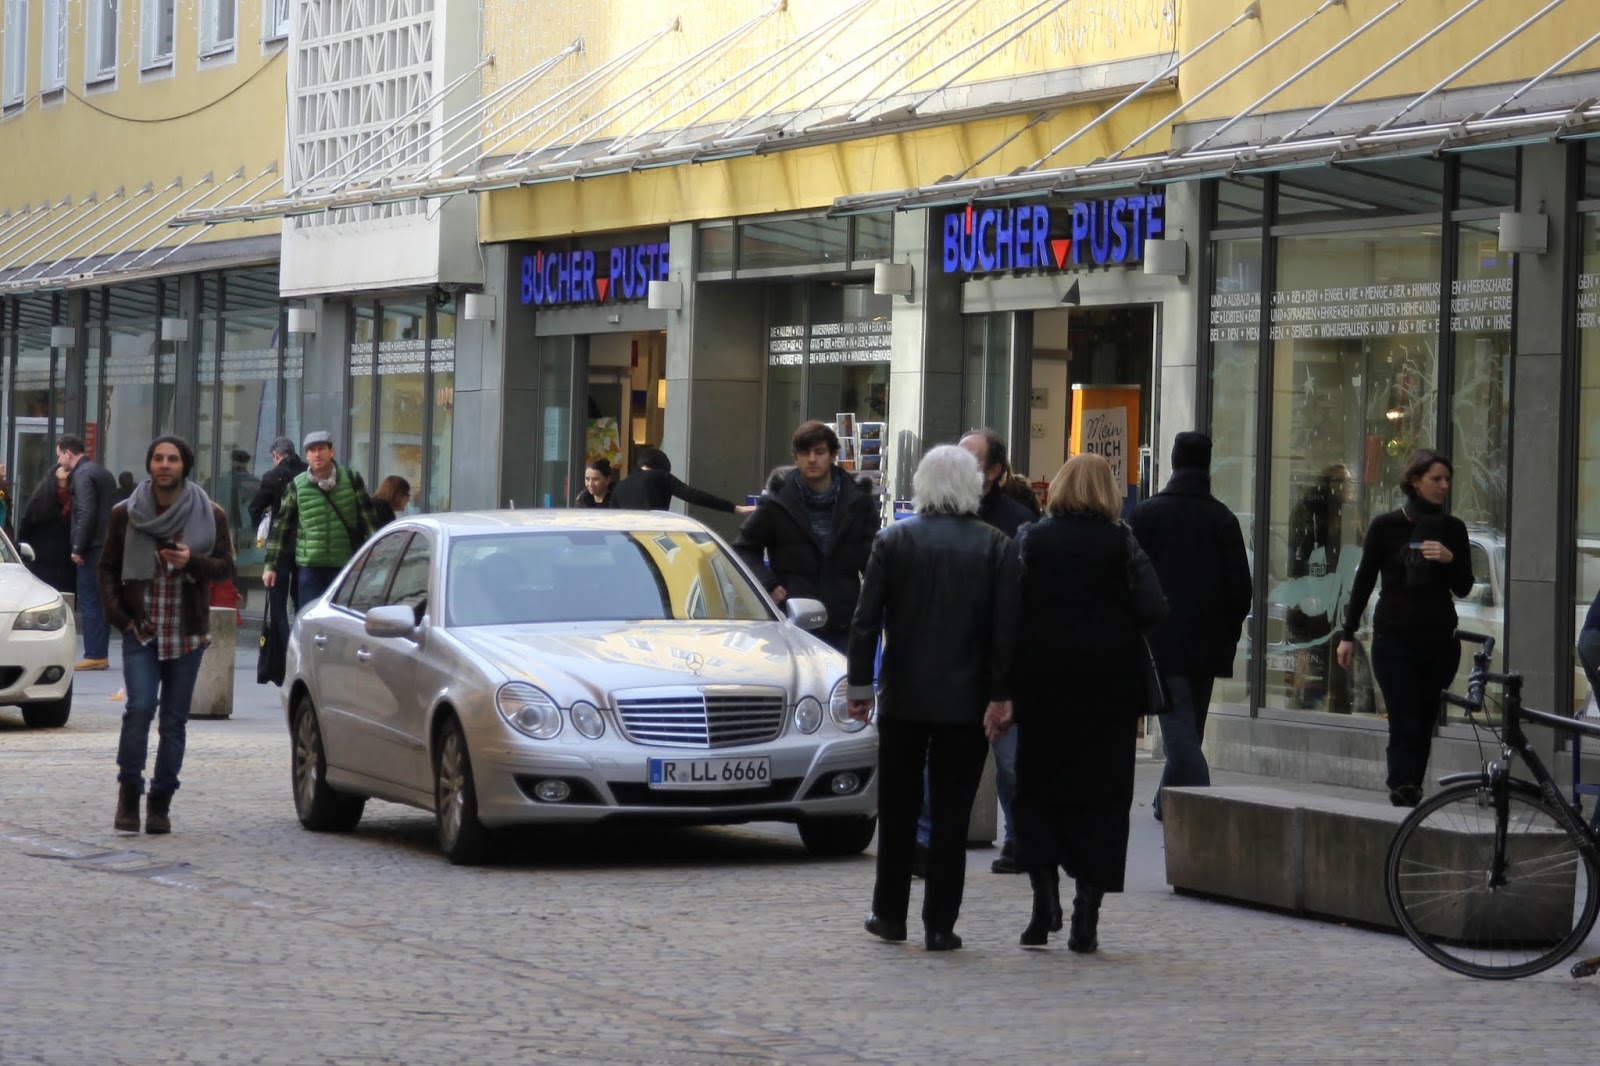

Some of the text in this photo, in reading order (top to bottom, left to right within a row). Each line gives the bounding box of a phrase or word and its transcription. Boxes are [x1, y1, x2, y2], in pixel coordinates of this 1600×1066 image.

[1577, 274, 1594, 290] GEN
[1211, 294, 1222, 307] UND
[1227, 292, 1250, 306] ALSBALD
[1324, 287, 1345, 301] ENGEL
[1349, 287, 1358, 300] DIE
[1365, 285, 1388, 299] MENGE
[1393, 284, 1406, 298] DER
[1474, 297, 1488, 311] AUF
[1577, 293, 1597, 309] NACH
[1211, 310, 1220, 323] DIE
[1223, 309, 1244, 323] LOBTEN
[1270, 308, 1283, 322] UND
[1286, 306, 1317, 321] SPRACHEN
[1320, 305, 1337, 319] EHRE
[1340, 305, 1350, 318] SEI
[1354, 304, 1369, 317] GOTT
[1372, 303, 1379, 316] IN
[1383, 302, 1396, 316] DER
[1422, 300, 1437, 314] UND
[1450, 316, 1463, 331] GEL
[1469, 315, 1484, 330] VON
[1576, 312, 1597, 328] HERR
[1210, 328, 1219, 341] BEI
[1227, 328, 1239, 340] DEN
[1291, 324, 1313, 338] SEINES
[1321, 321, 1370, 336] WOHLGEFALLENS
[1375, 321, 1390, 334] UND
[1397, 320, 1409, 334] ALS
[1416, 319, 1426, 333] DIE
[1086, 414, 1122, 440] Mein
[664, 761, 767, 781] R LL 6666
